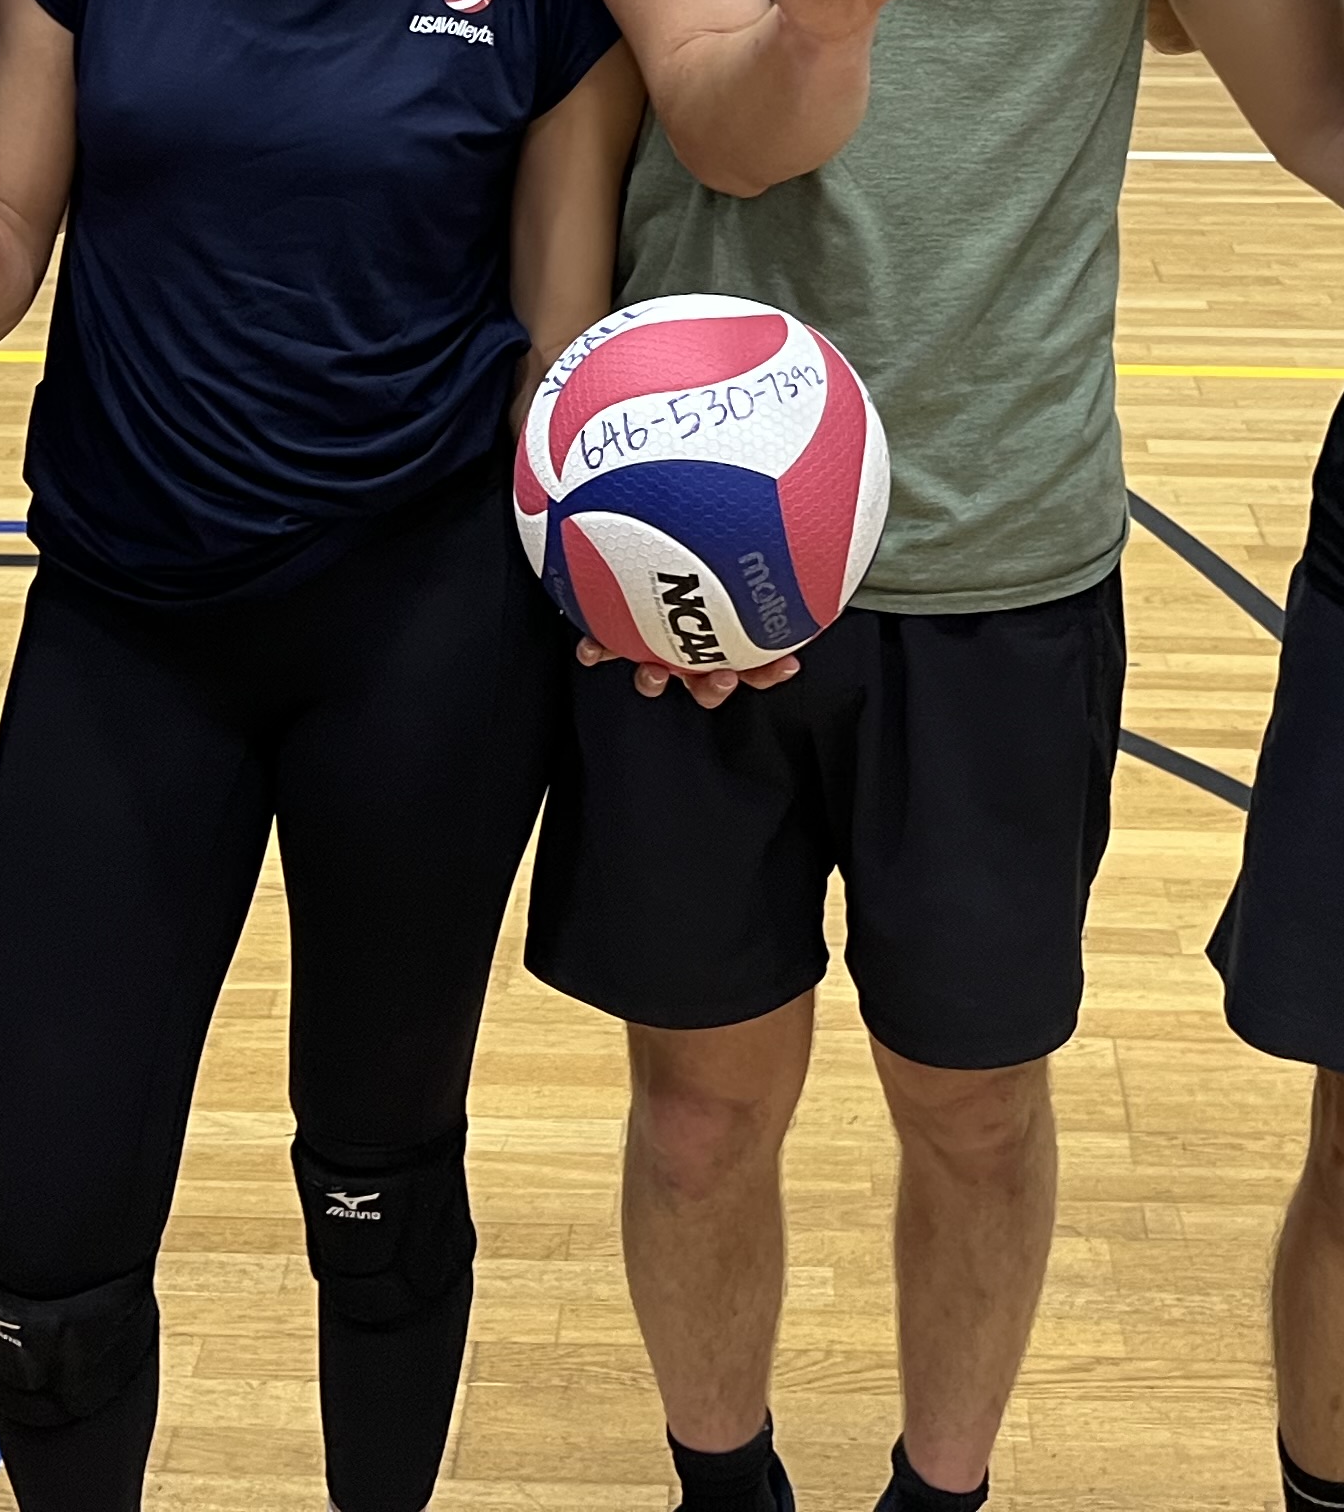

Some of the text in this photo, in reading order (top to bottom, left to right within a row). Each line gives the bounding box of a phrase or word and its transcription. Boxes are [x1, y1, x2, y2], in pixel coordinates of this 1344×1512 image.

[580, 366, 825, 470] 646-530-7392
[656, 572, 728, 665] NCAA
[737, 551, 792, 645] molten
